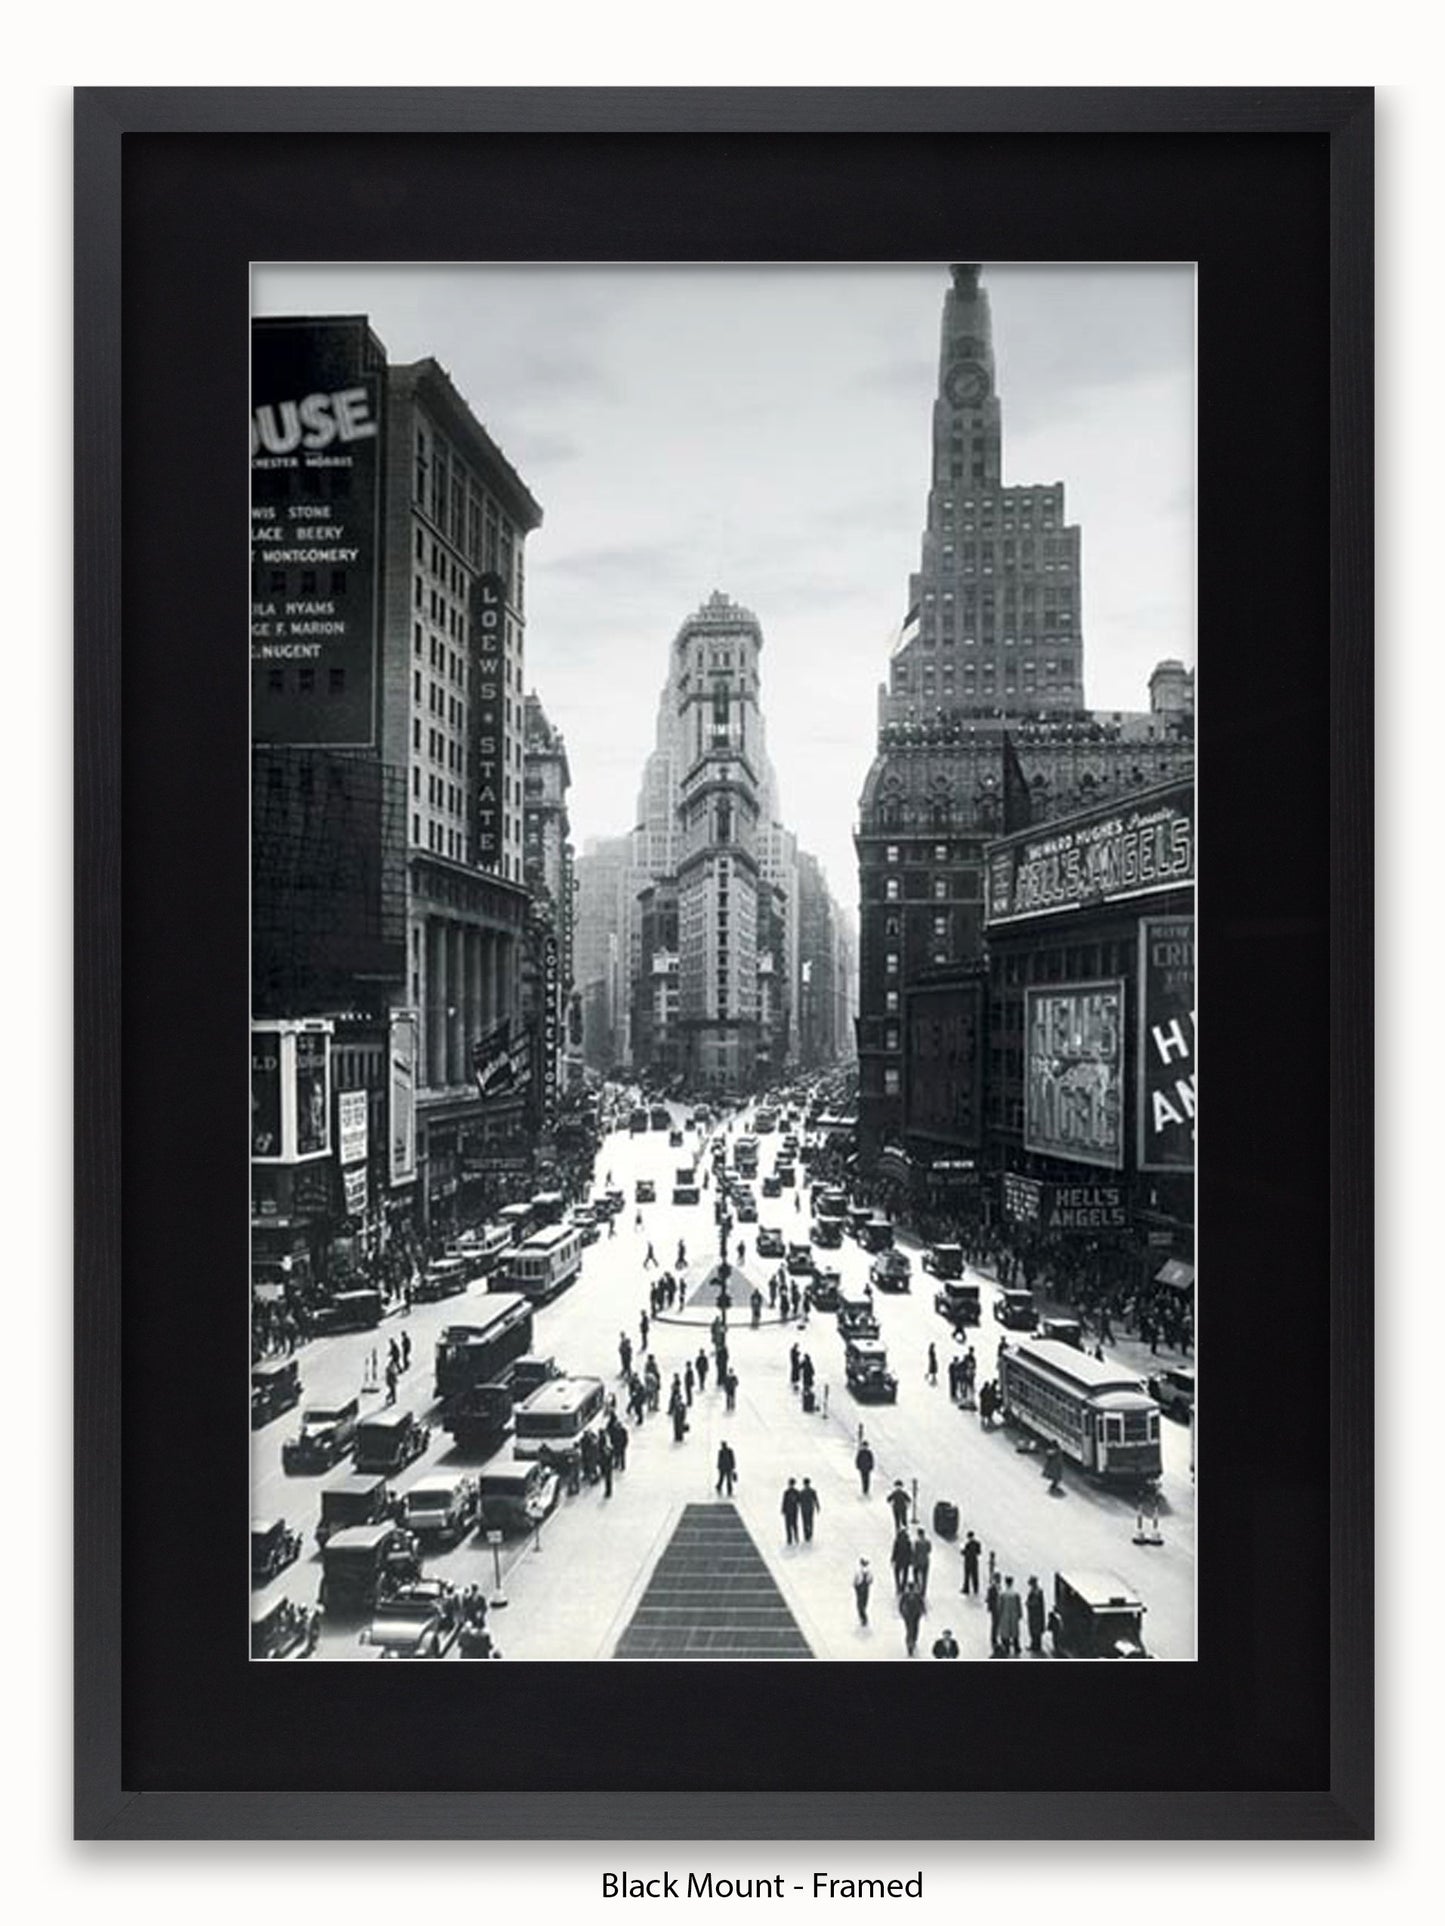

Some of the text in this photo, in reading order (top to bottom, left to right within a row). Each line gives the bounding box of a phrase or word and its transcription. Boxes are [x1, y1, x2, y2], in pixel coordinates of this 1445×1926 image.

[288, 505, 331, 519] STONE
[297, 525, 344, 540] BEERY
[262, 548, 360, 562] MONTGOMERY
[480, 736, 496, 850] STATE
[1152, 1011, 1194, 1065] H
[1049, 1208, 1125, 1227] ANGELS
